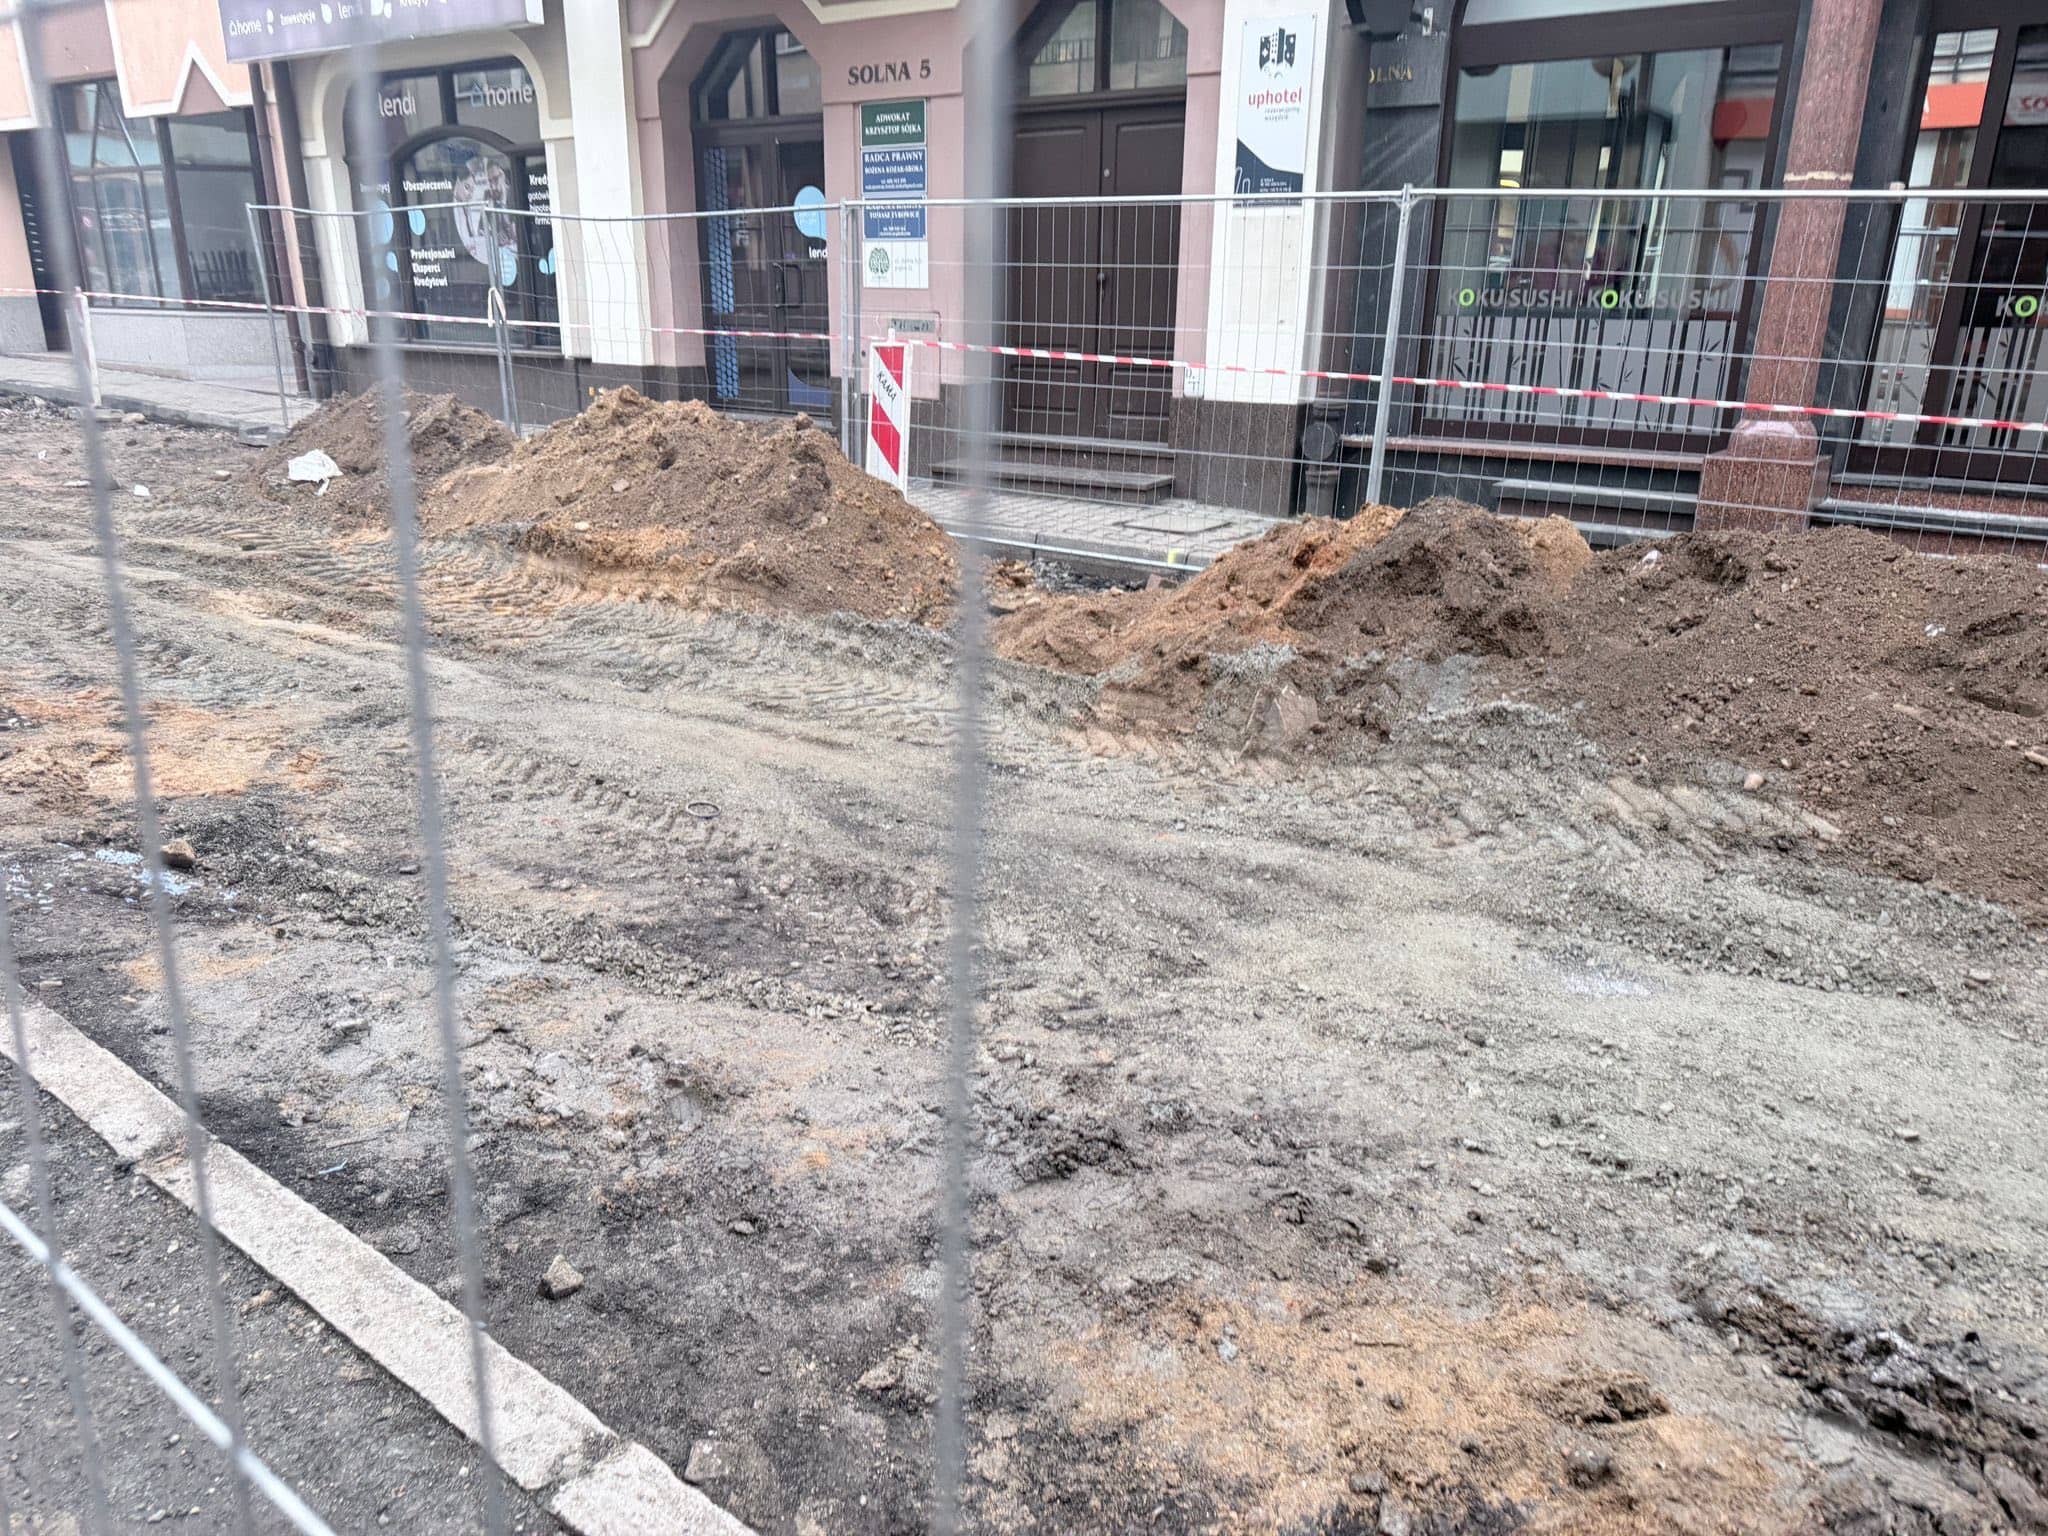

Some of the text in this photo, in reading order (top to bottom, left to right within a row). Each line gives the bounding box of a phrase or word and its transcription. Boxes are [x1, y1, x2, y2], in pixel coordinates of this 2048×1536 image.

[848, 58, 931, 86] SOLNA 5
[485, 81, 534, 108] home
[1248, 86, 1303, 109] uphotel
[377, 91, 417, 118] lendi
[875, 112, 911, 123] ADWOKAT
[864, 124, 900, 136] KRZYSZTOF
[864, 151, 923, 163] RADCA PRAWNY
[402, 179, 453, 193] Ubezpieczenia
[528, 173, 548, 186] Kred
[410, 247, 456, 262] Profesjonalni
[808, 246, 829, 260] lend
[411, 261, 441, 275] Eksperci
[413, 275, 449, 290] Kredytowi
[1449, 287, 1574, 309] KOKU SUSHI
[1586, 288, 1729, 310] KOKU SUSHI
[876, 370, 897, 401] KAMA
